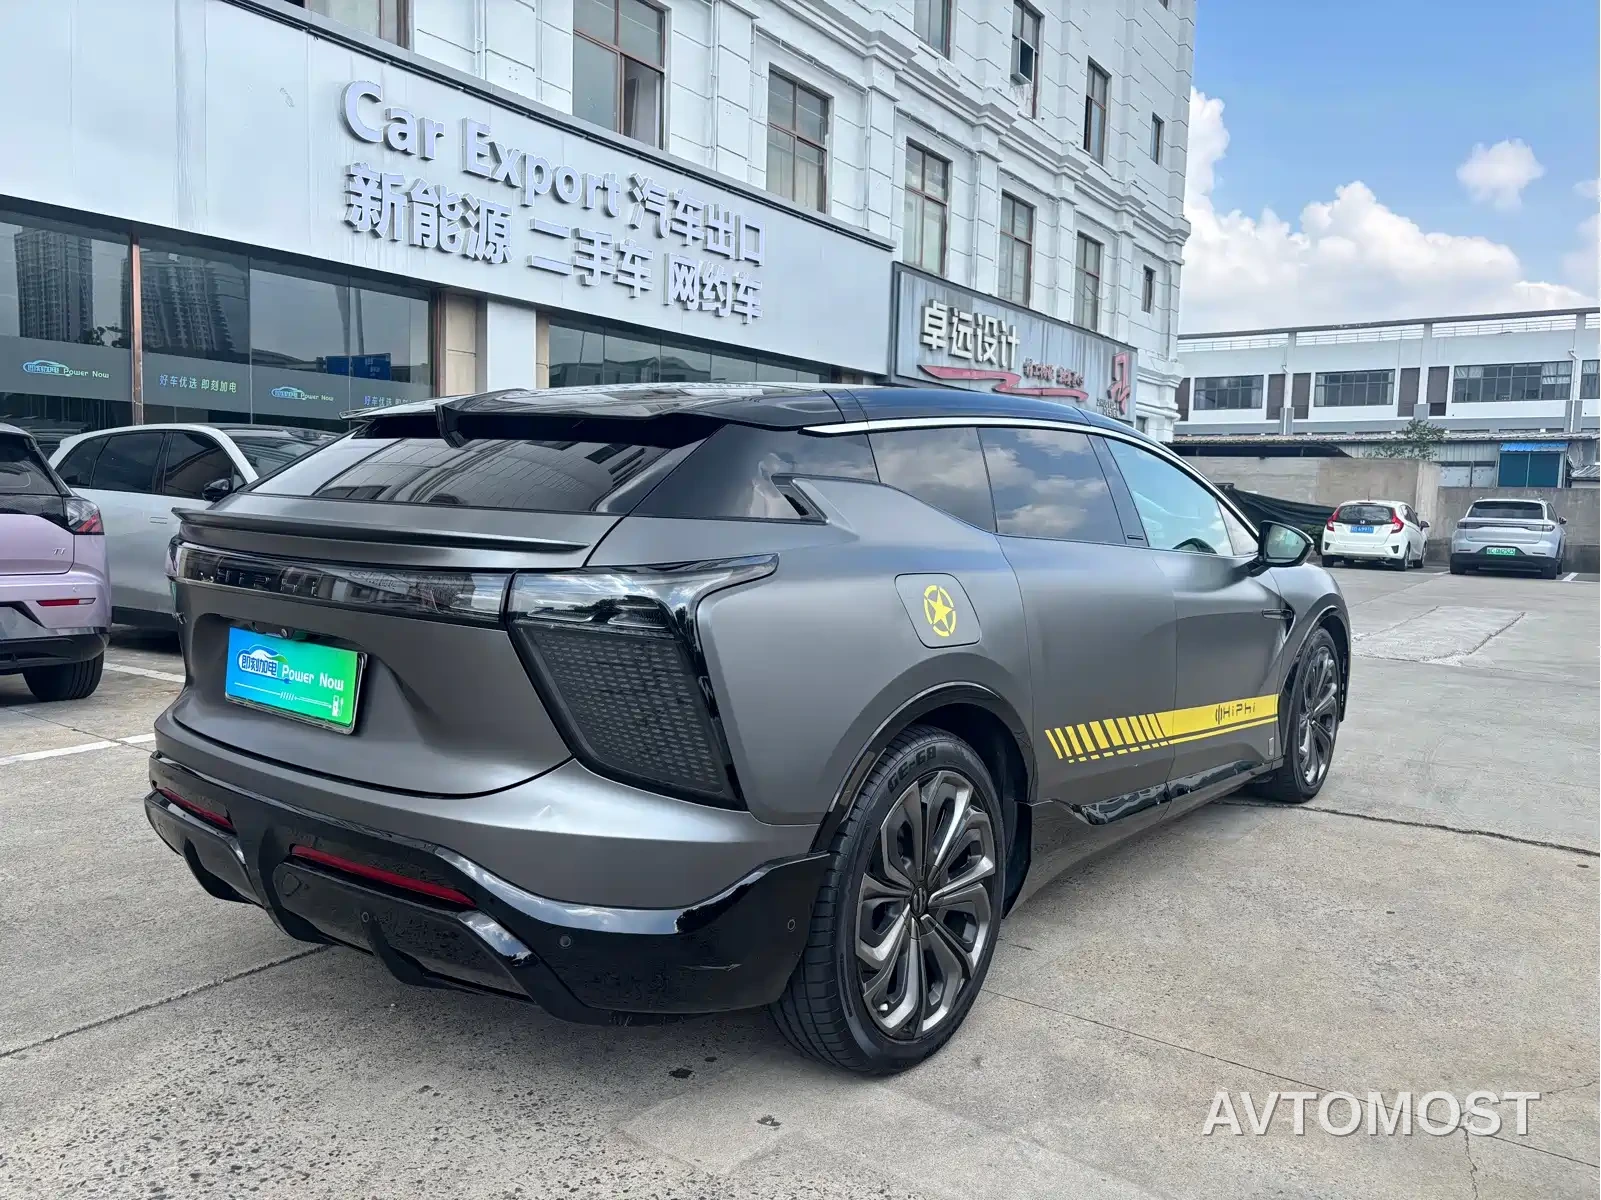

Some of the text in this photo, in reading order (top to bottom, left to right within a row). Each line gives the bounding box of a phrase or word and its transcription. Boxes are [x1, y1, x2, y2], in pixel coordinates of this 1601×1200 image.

[340, 80, 766, 267] Car Export 汽车出口
[345, 162, 763, 325] 新能源 二手车 网约车
[920, 298, 1020, 371] 卓远设计
[63, 367, 89, 377] Power
[92, 370, 110, 379] Now
[160, 374, 238, 394] 好车优选 即刻加电
[300, 389, 320, 400] Power
[321, 394, 335, 402] Now
[241, 653, 345, 692] 即刻加电 Power Now
